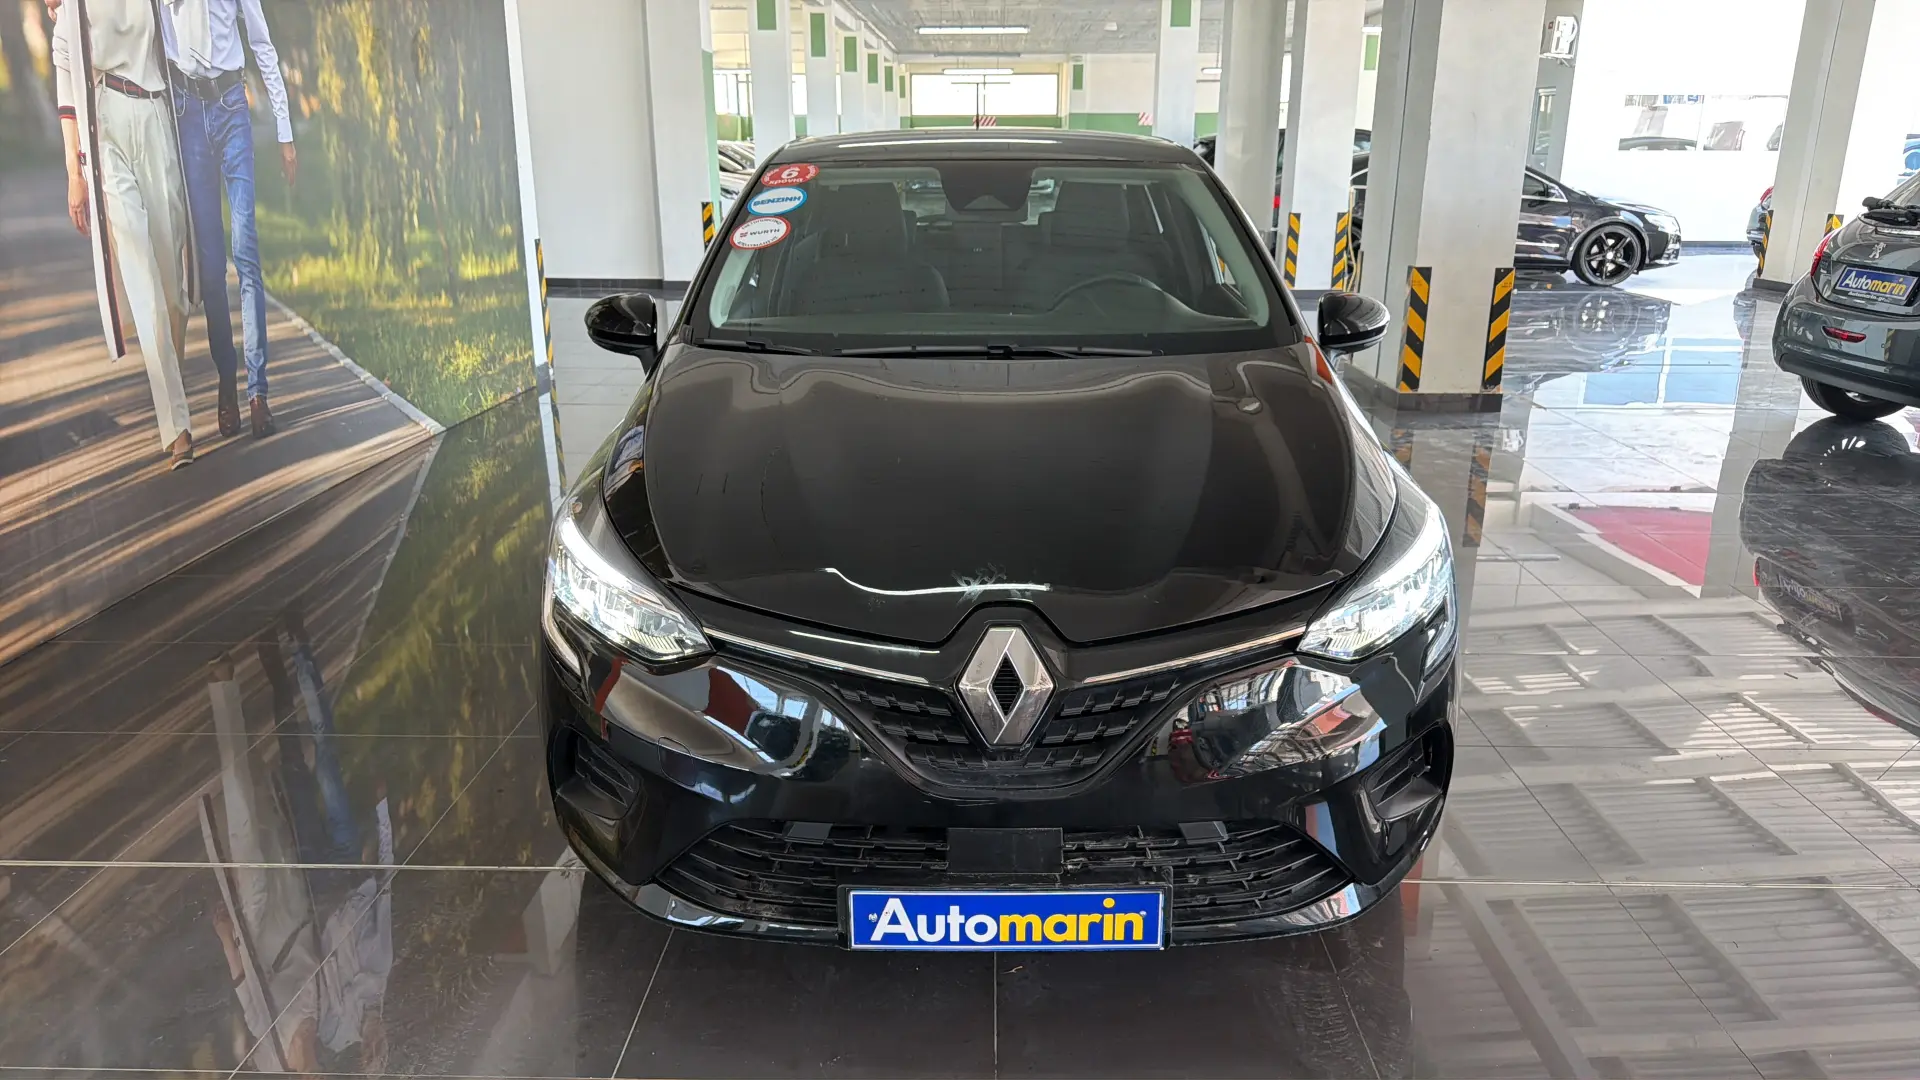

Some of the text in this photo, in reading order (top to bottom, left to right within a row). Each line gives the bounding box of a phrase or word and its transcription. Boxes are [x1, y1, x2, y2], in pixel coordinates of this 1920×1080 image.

[781, 167, 800, 179] 6
[1842, 270, 1907, 296] Automarin
[870, 898, 1143, 942] Automarin
